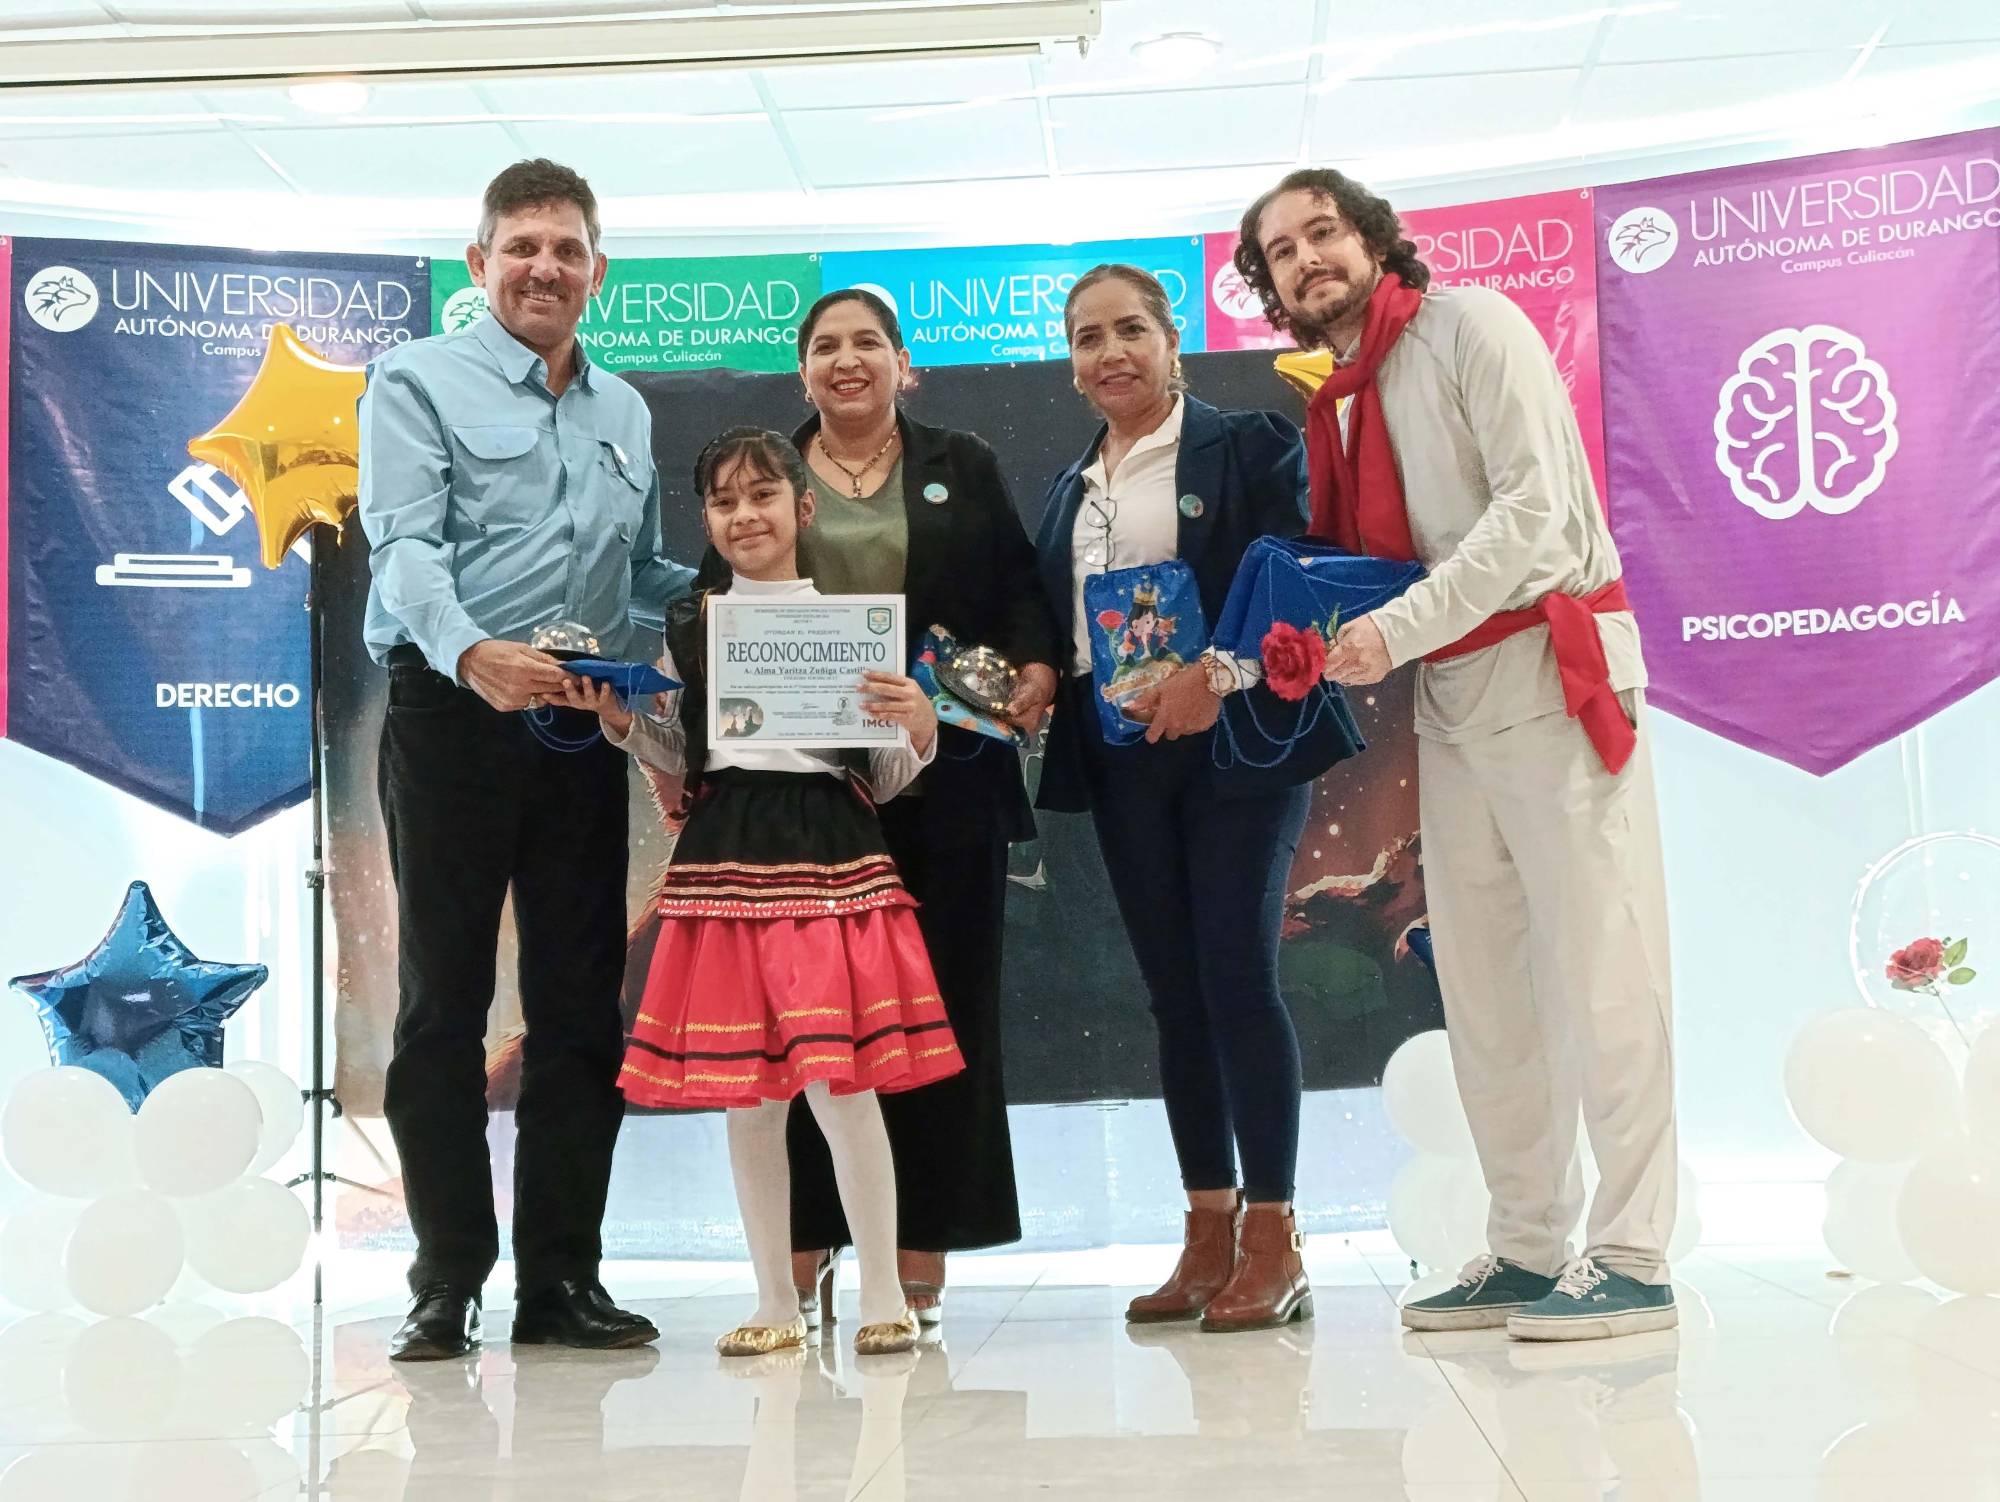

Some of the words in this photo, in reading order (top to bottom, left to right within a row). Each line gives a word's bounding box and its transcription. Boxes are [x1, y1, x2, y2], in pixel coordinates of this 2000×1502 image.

[1690, 158, 2000, 241] UNIVERSIDAD
[1411, 218, 1573, 274] RSIDAD
[1693, 235, 1834, 268] AUTÓNOMA
[1841, 227, 1871, 248] DE
[1878, 207, 2000, 243] DURANGO
[1781, 256, 1843, 274] Campus
[1847, 246, 1915, 266] Culiacán
[112, 269, 412, 321] UNIVERSIDAD
[577, 280, 800, 324] IVERSIDAD
[910, 269, 1187, 320] UNIVERSD
[114, 315, 254, 340] AUTÓNOMA
[296, 325, 412, 345] DURANGO
[576, 330, 651, 348] NOMA
[658, 329, 684, 346] DE
[690, 327, 799, 345] DURANGO
[912, 320, 1038, 343] AUTÓNOMA
[202, 342, 262, 359] Campus
[603, 351, 659, 365] Campus
[662, 349, 722, 363] Culiacán
[1682, 590, 1966, 641] PSICOPEDAGOGÍA
[726, 641, 886, 663] RECONOCIMIENTO
[754, 667, 776, 675] Alma
[779, 666, 807, 675] Yaritza
[809, 666, 837, 676] Zuñiga
[156, 683, 300, 708] DERECHO
